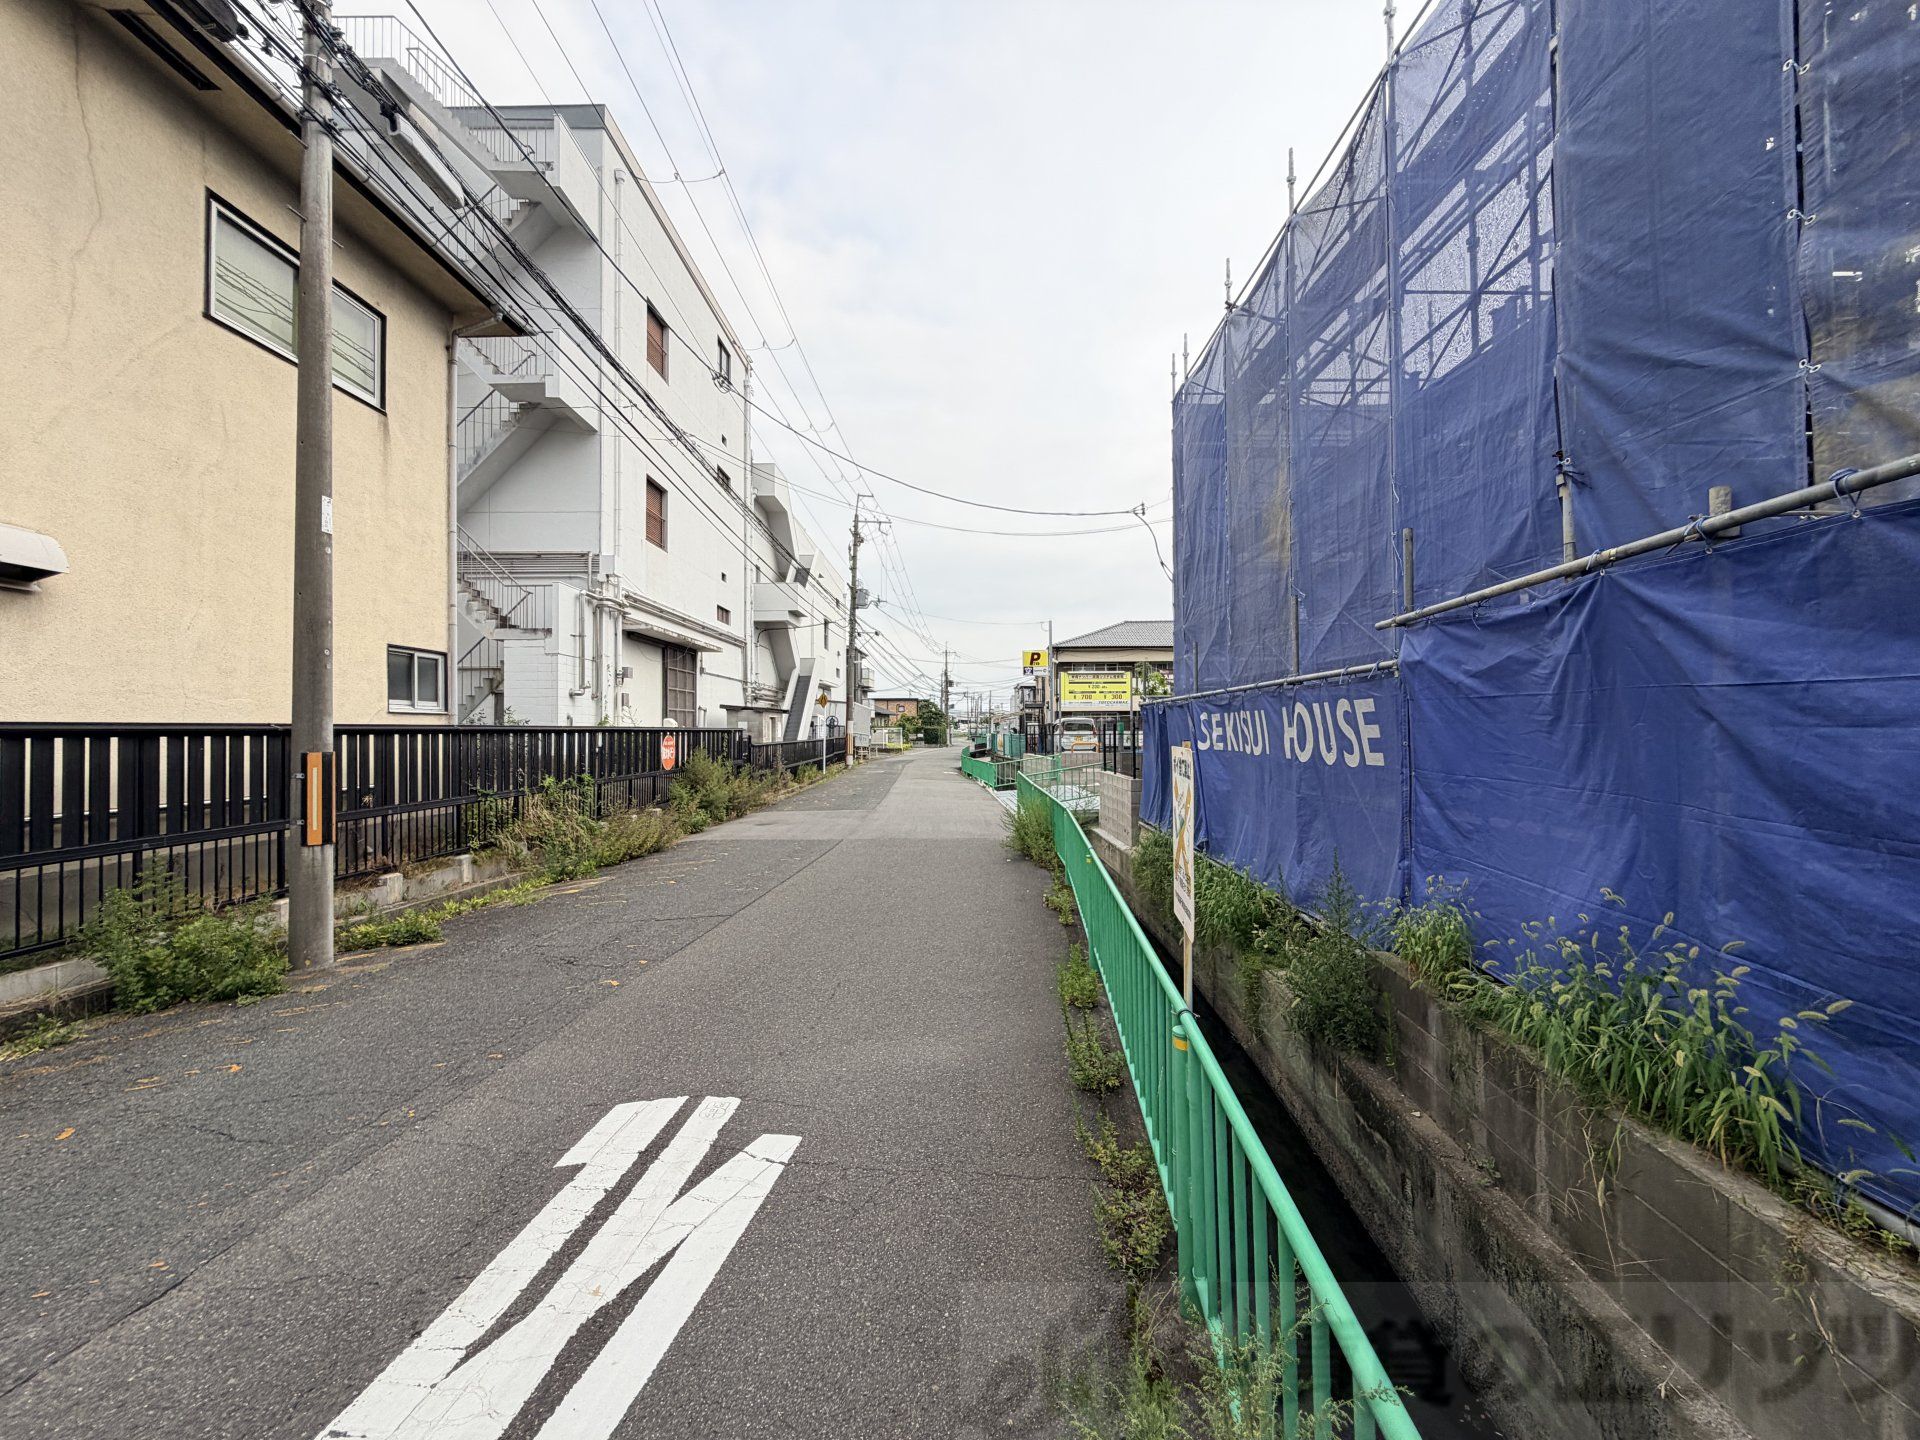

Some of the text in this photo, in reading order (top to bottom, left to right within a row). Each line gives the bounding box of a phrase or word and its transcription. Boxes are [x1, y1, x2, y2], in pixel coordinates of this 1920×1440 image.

[1029, 652, 1041, 665] P
[1197, 698, 1385, 768] SEKISUI HOUSE
